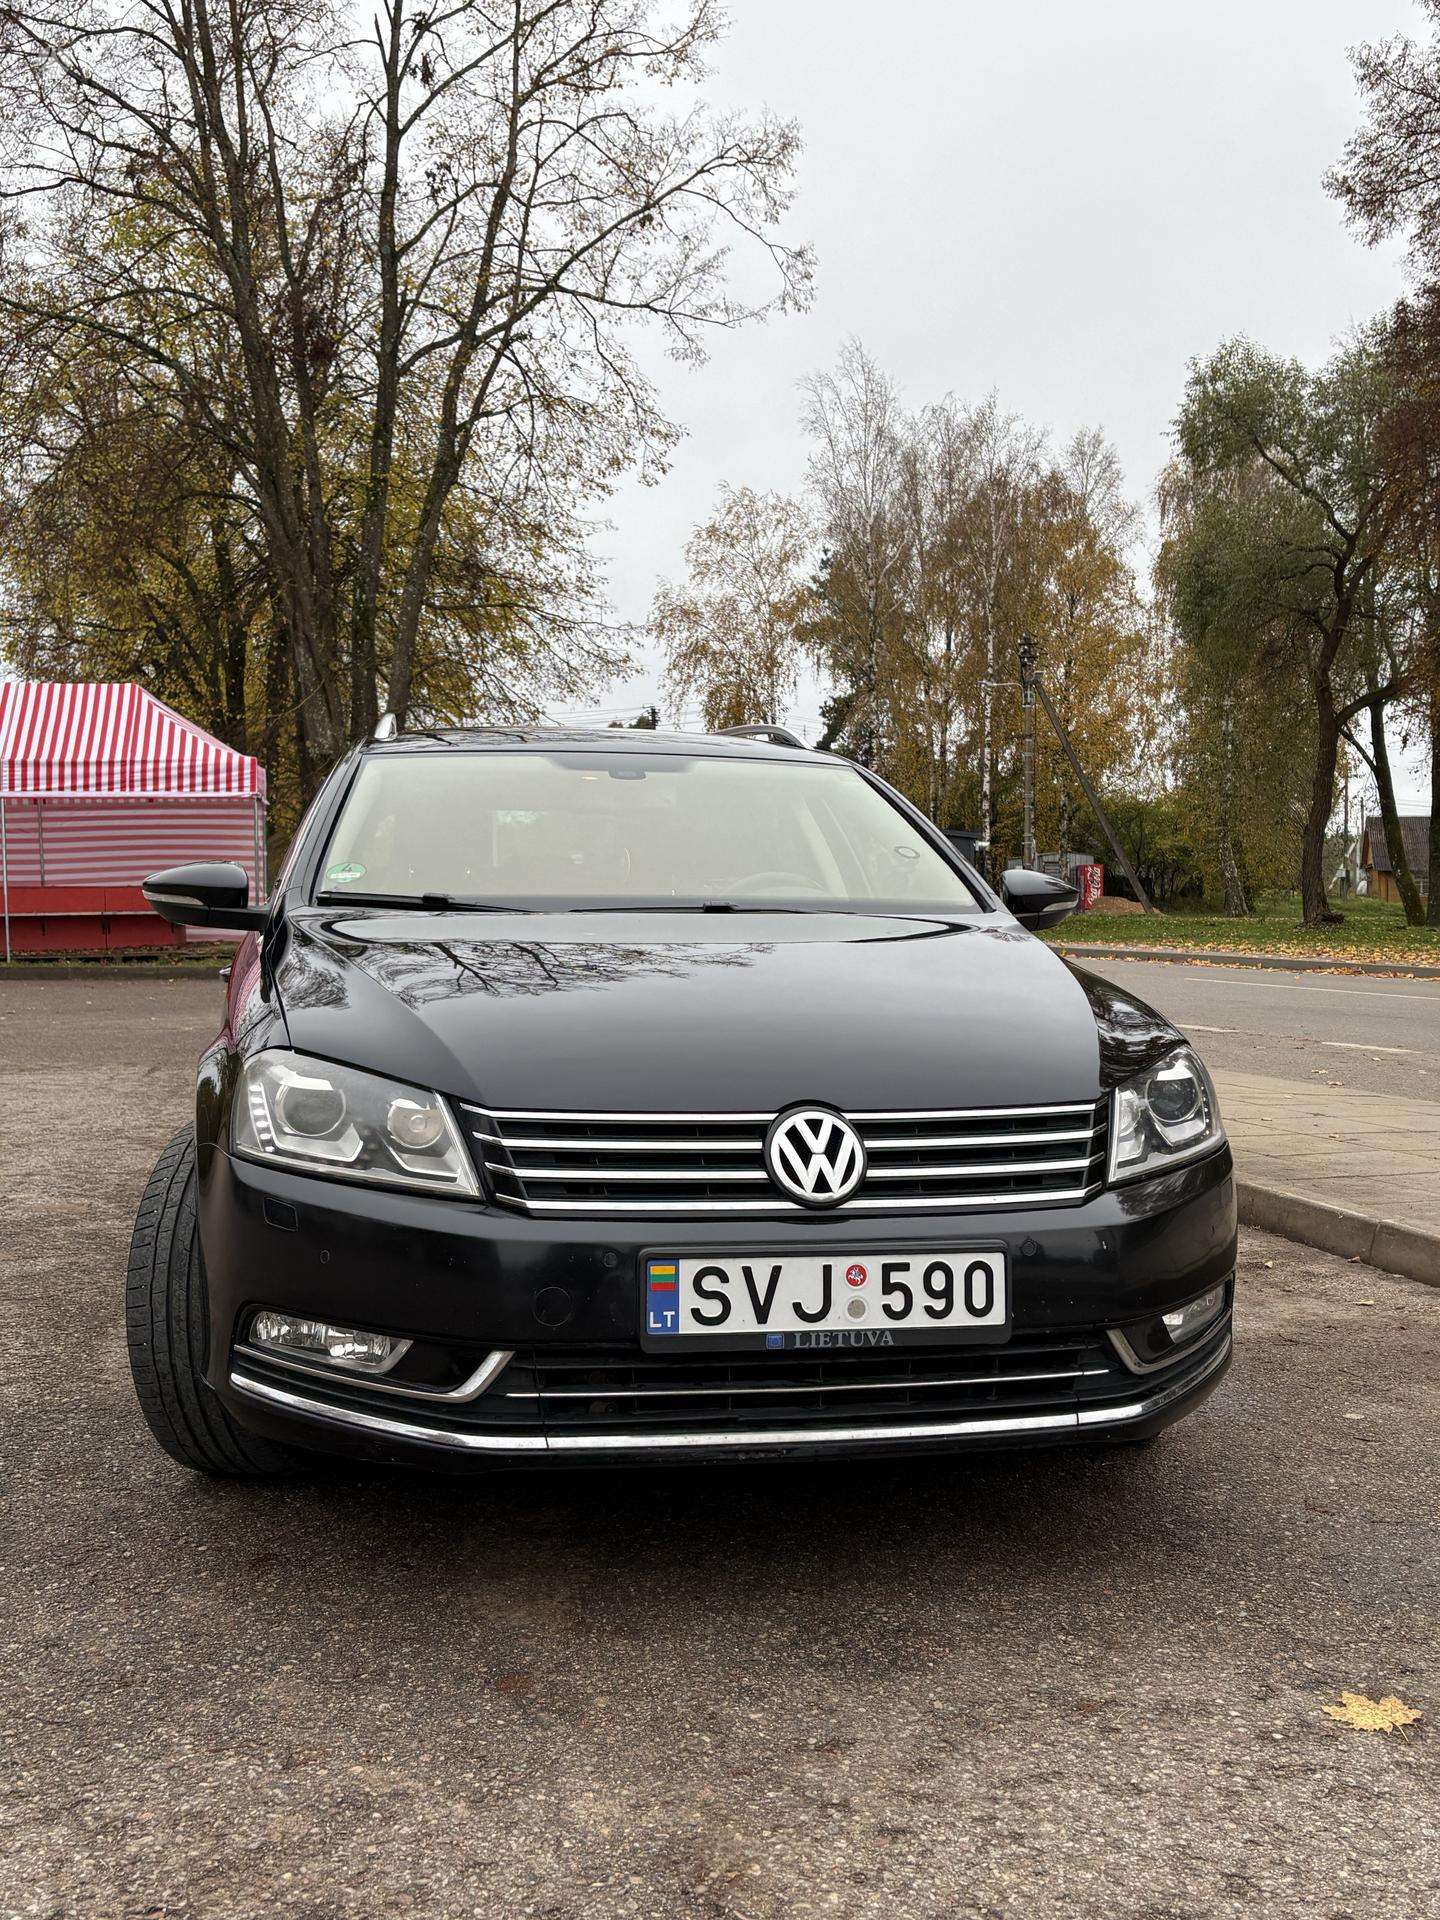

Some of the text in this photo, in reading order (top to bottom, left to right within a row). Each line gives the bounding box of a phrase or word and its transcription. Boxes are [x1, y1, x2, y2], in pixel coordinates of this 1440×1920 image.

[771, 1111, 863, 1200] VW
[690, 1259, 995, 1327] SVJ 590
[650, 1311, 675, 1329] LT
[793, 1330, 895, 1349] LIETUVA
